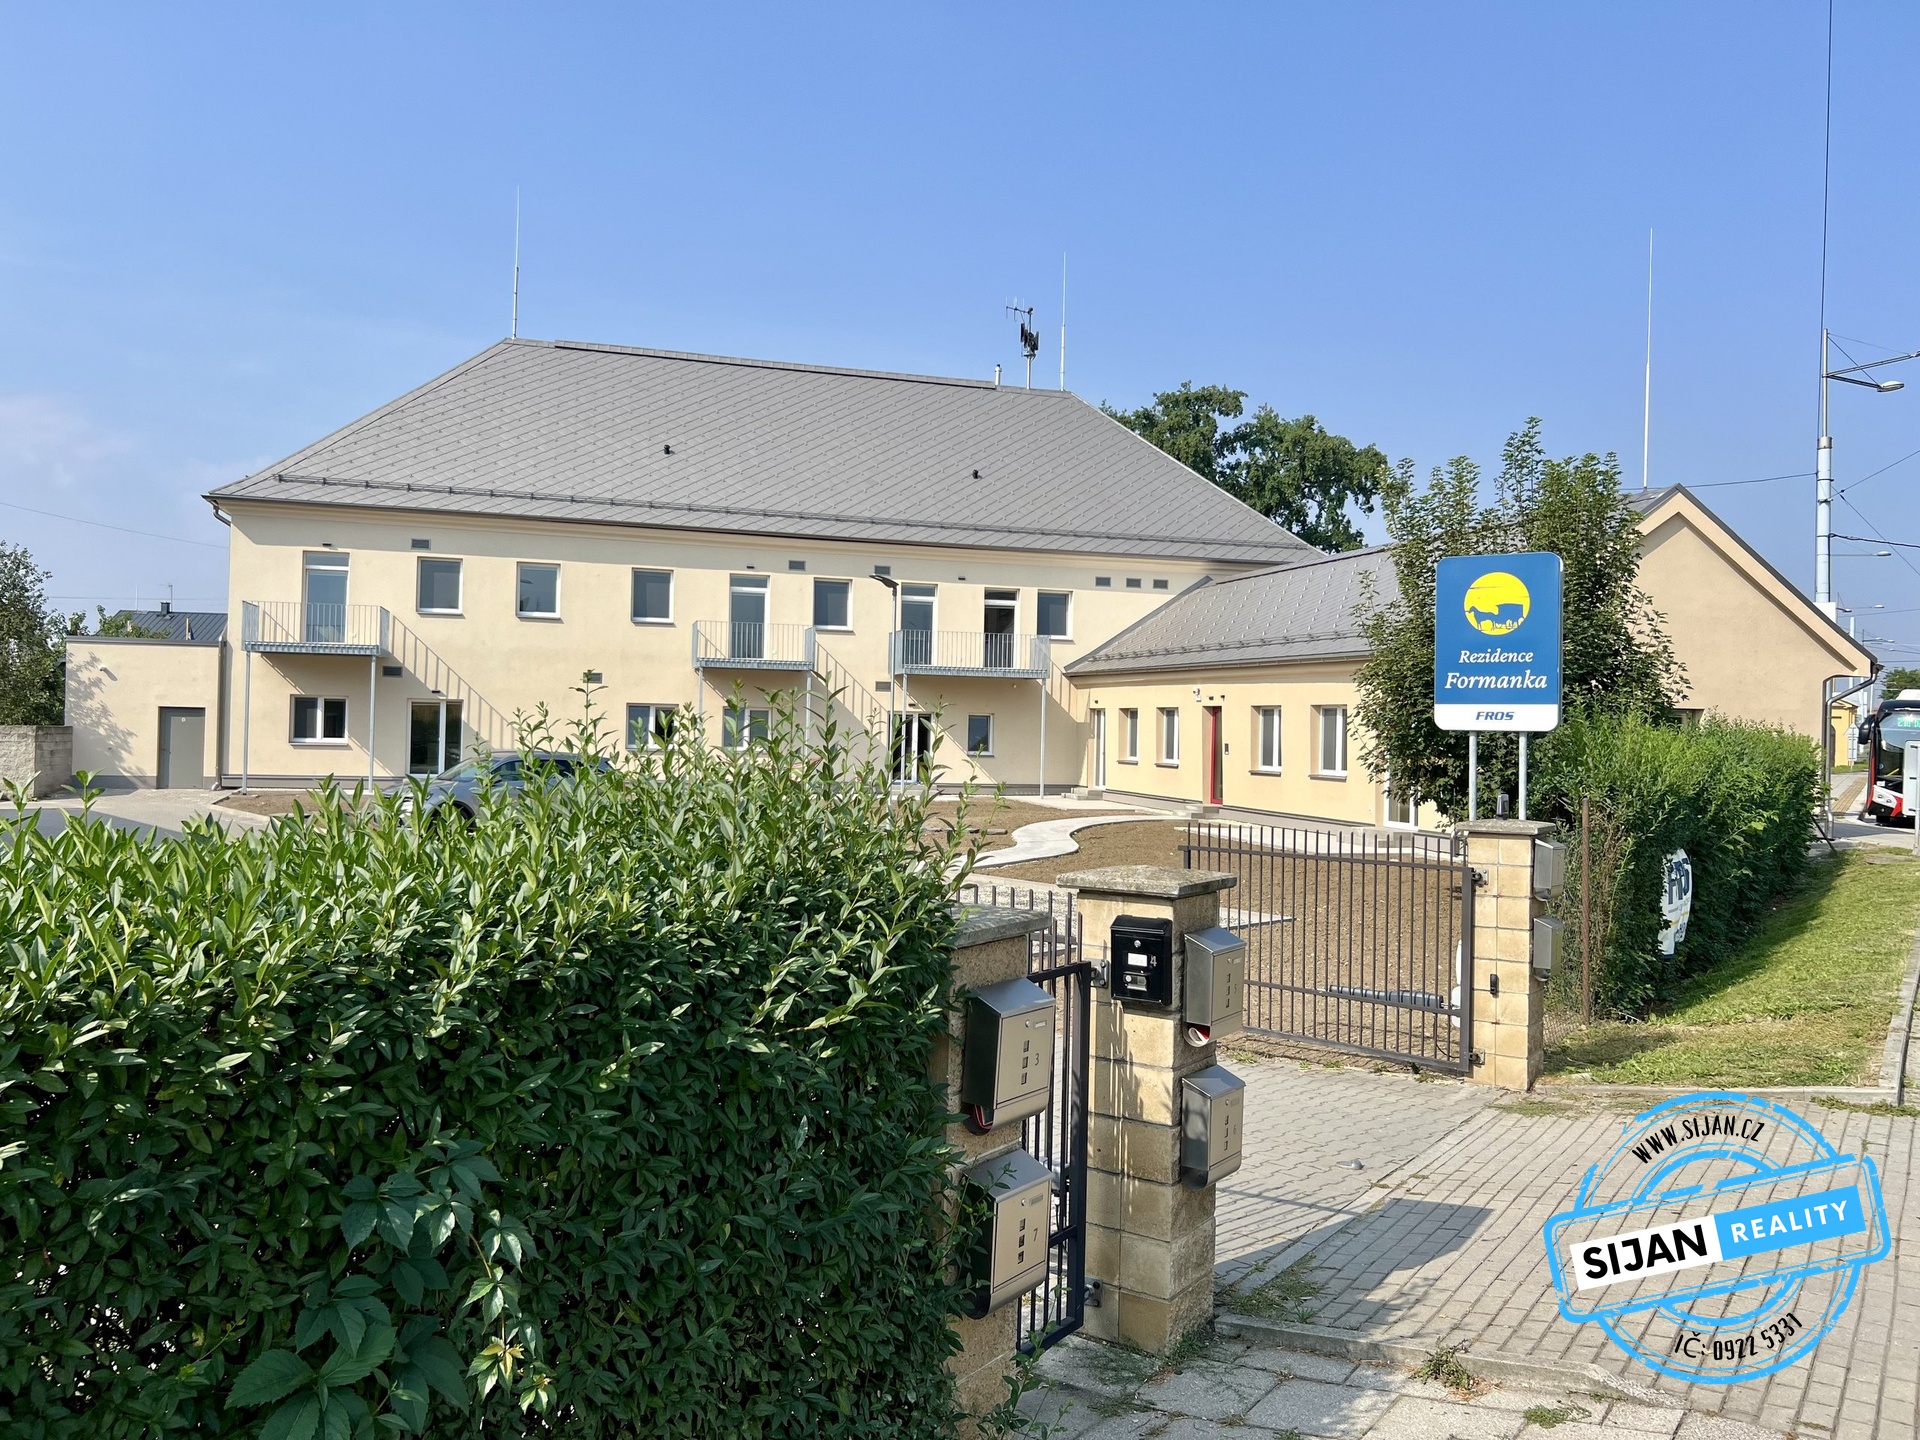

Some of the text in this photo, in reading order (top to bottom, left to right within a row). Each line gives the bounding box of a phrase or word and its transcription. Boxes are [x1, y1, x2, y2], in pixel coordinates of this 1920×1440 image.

[1458, 648, 1533, 664] Rezidence
[1444, 669, 1548, 689] Formanka
[1475, 711, 1515, 721] FROS
[1150, 955, 1157, 967] 4
[1034, 1052, 1040, 1066] 3
[1033, 1227, 1039, 1242] 7
